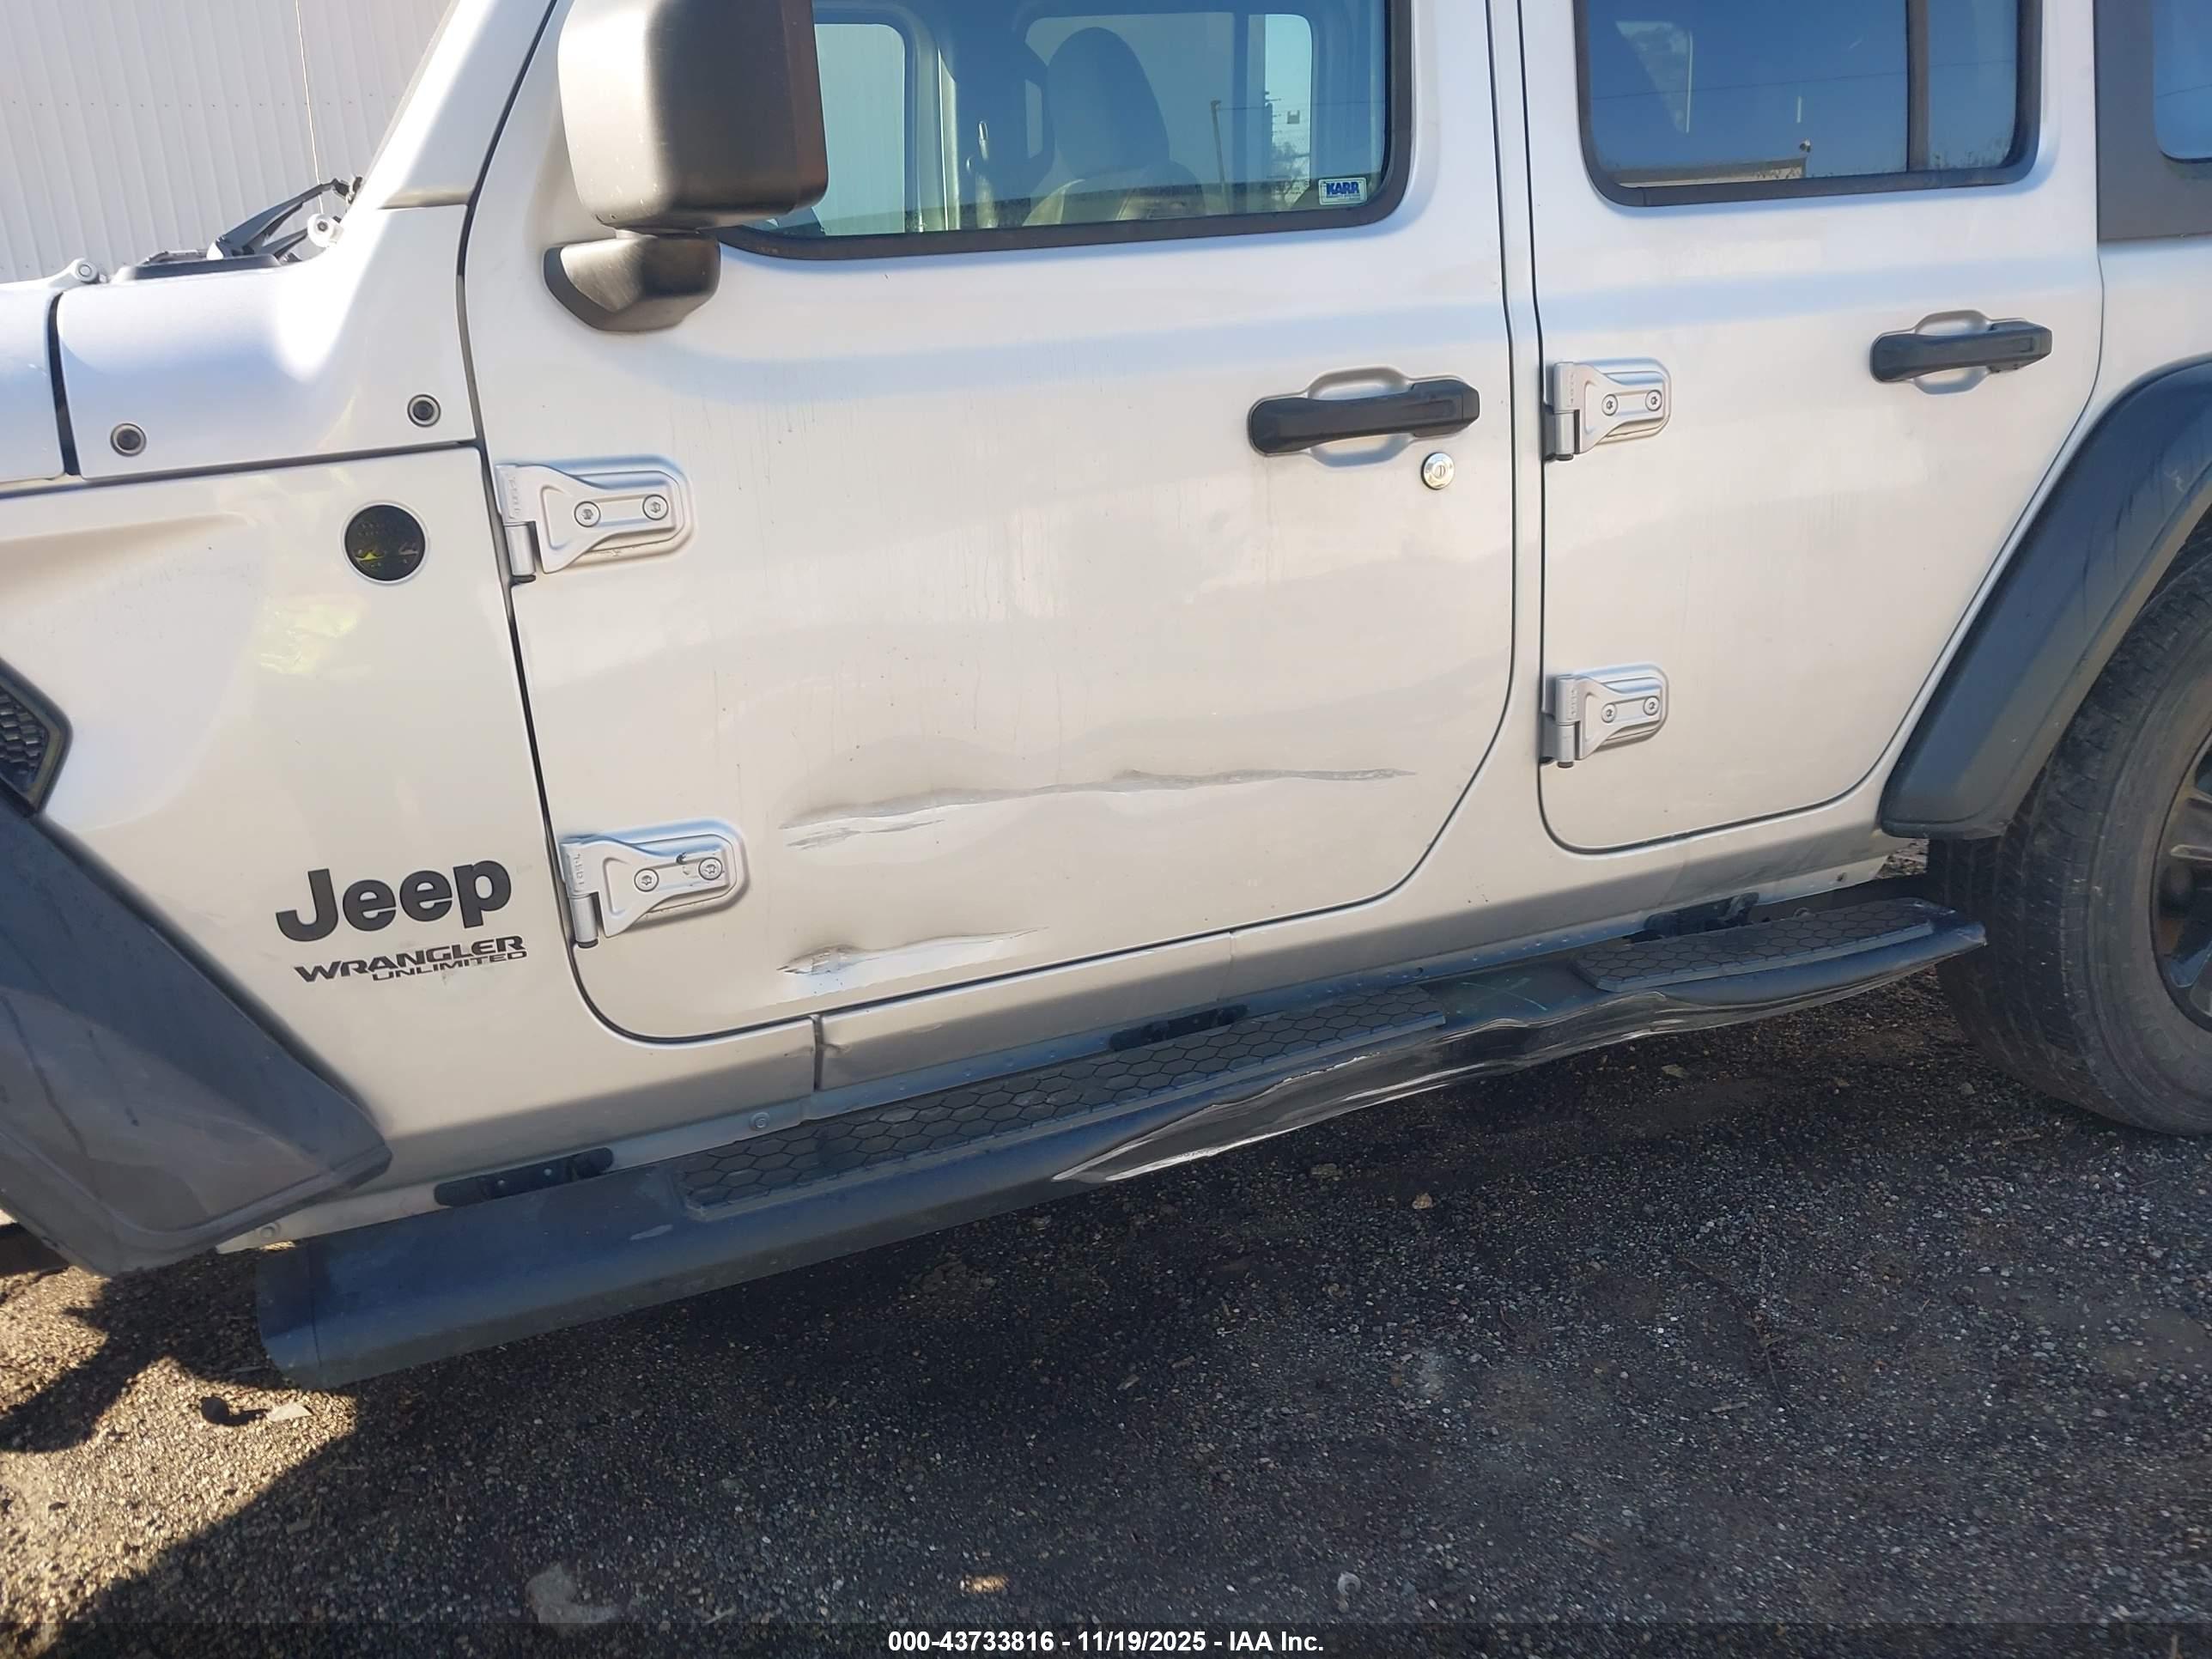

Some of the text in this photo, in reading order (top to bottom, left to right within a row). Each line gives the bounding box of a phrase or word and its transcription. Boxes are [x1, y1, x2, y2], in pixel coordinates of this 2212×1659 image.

[1327, 181, 1359, 195] KARR
[276, 860, 512, 942] Jeep
[295, 935, 526, 982] WRANGLER
[372, 951, 528, 981] UNLIMITED
